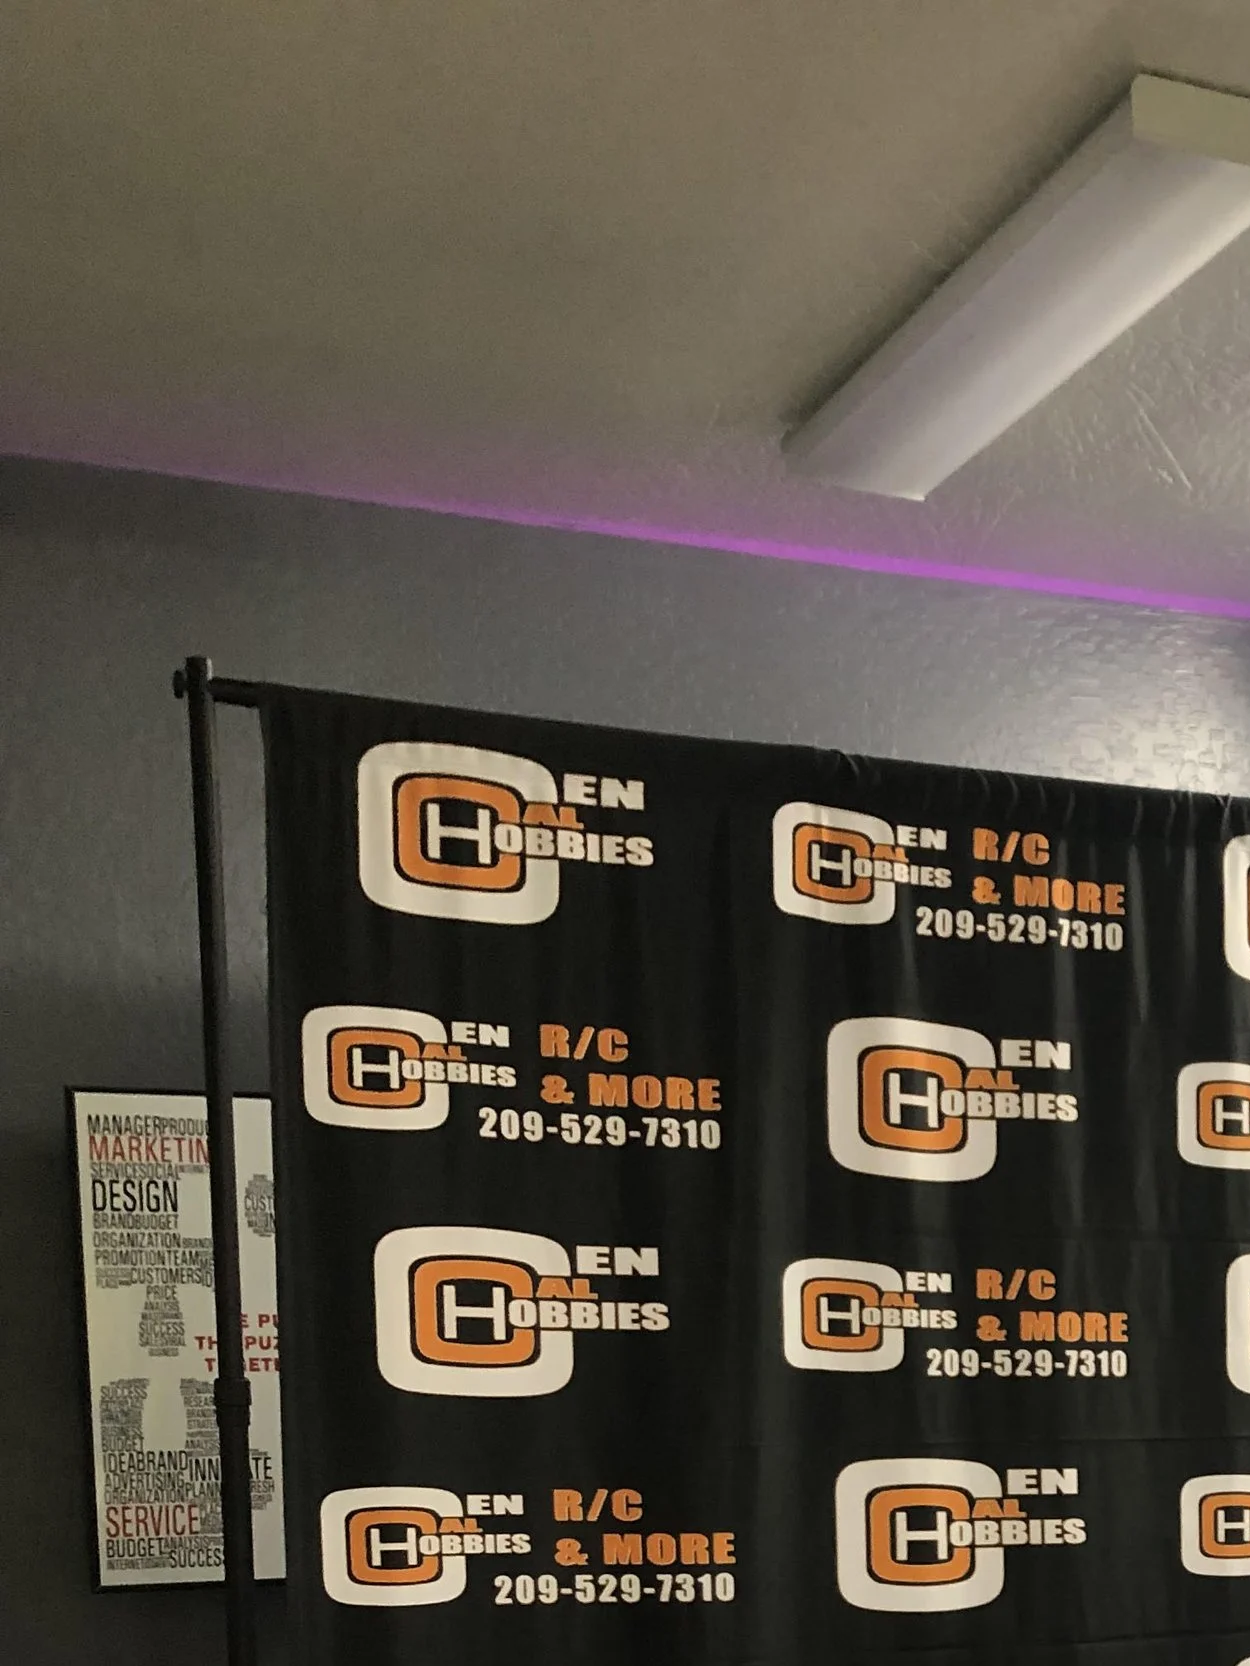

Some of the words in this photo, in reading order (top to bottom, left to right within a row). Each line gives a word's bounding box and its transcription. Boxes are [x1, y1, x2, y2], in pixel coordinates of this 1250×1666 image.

[973, 828, 1048, 864] R/C
[972, 876, 999, 903] &
[1014, 875, 1122, 914] MORE
[917, 907, 1124, 950] 209-529-7310
[540, 1024, 628, 1062] R/C
[541, 1075, 573, 1104] &
[589, 1073, 720, 1111] MORE
[88, 1114, 161, 1136] MANAGER
[479, 1107, 720, 1148] 209-529-7310
[92, 1179, 178, 1212] DESIGN
[93, 1231, 181, 1248] ORGANIZATION
[95, 1250, 165, 1266] PROMOTION
[165, 1250, 200, 1266] TEAM
[146, 1285, 177, 1301] PRICE
[977, 1269, 1055, 1300] R/C
[977, 1315, 1006, 1341] &
[1020, 1311, 1125, 1342] MORE
[927, 1349, 1126, 1377] 209-529-7310
[103, 1452, 136, 1473] IDEA
[136, 1450, 188, 1471] BRAND
[105, 1472, 184, 1489] ADVERTISING
[106, 1504, 199, 1537] SERVICE
[553, 1489, 640, 1521] R/C
[107, 1538, 164, 1557] BUDGET
[555, 1538, 588, 1565] &
[603, 1533, 734, 1565] MORE
[495, 1573, 734, 1604] 209-529-7310
